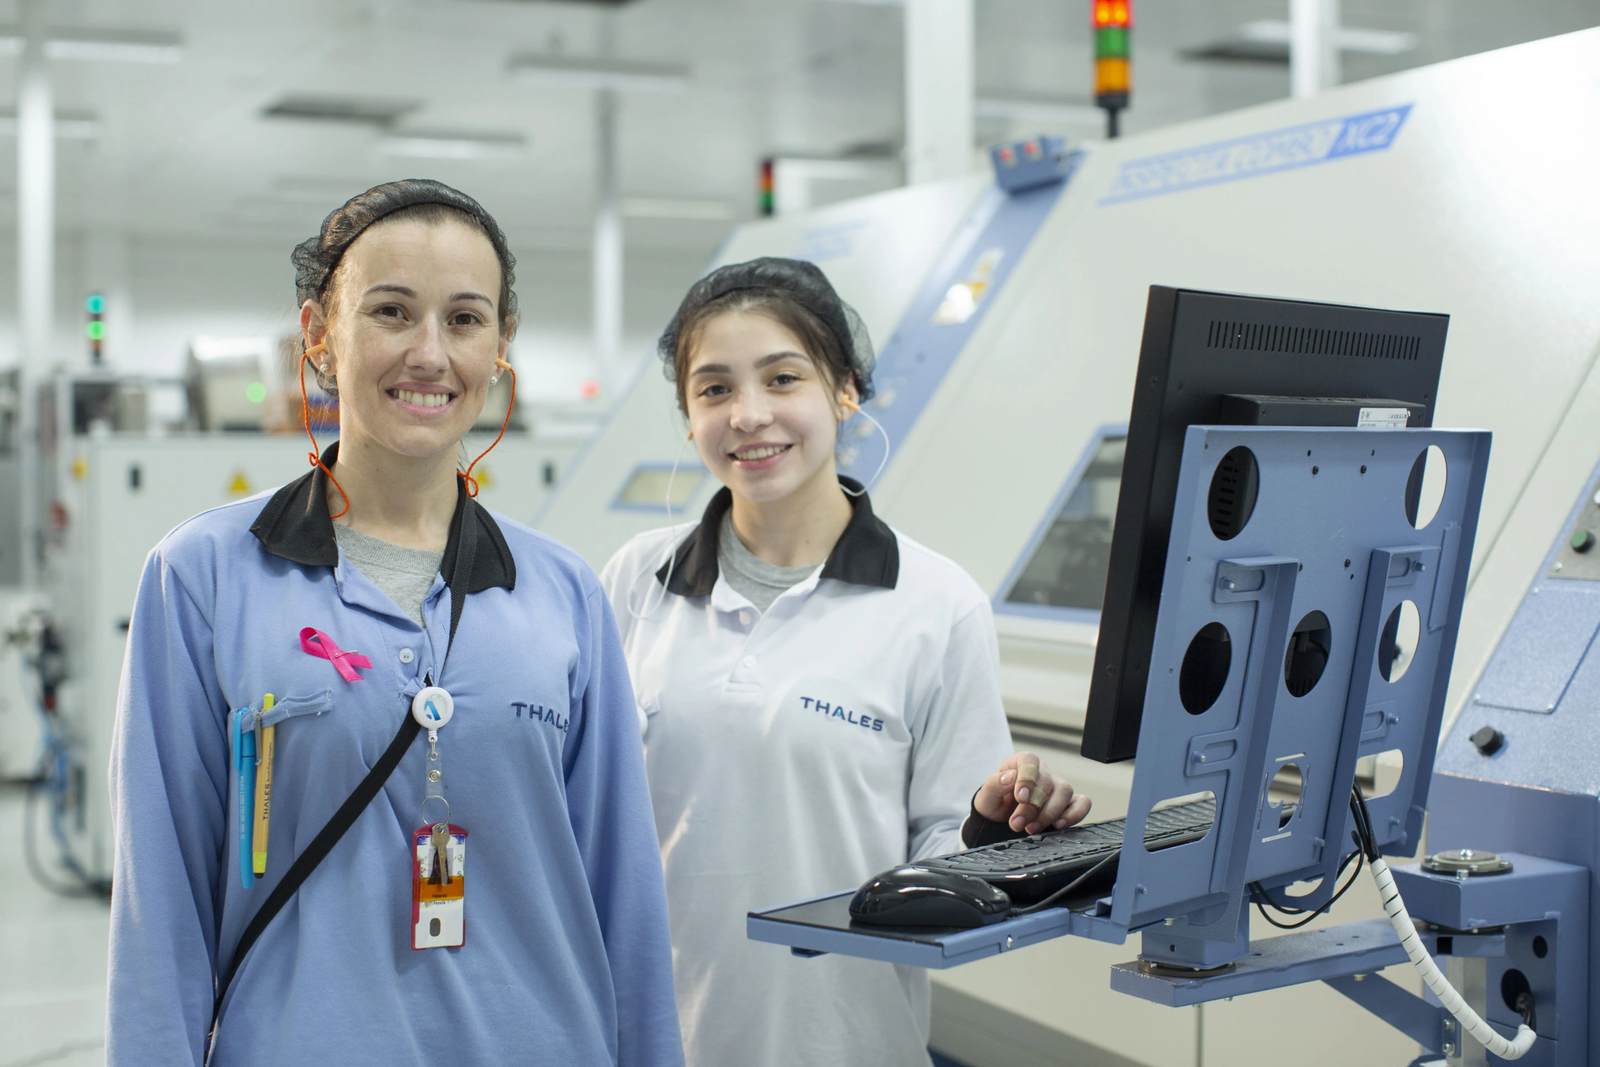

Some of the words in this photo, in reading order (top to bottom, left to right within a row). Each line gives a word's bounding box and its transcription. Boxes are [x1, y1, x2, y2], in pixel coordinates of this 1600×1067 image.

[511, 702, 570, 733] THALE
[800, 696, 884, 732] THALES
[263, 783, 271, 821] THALES
